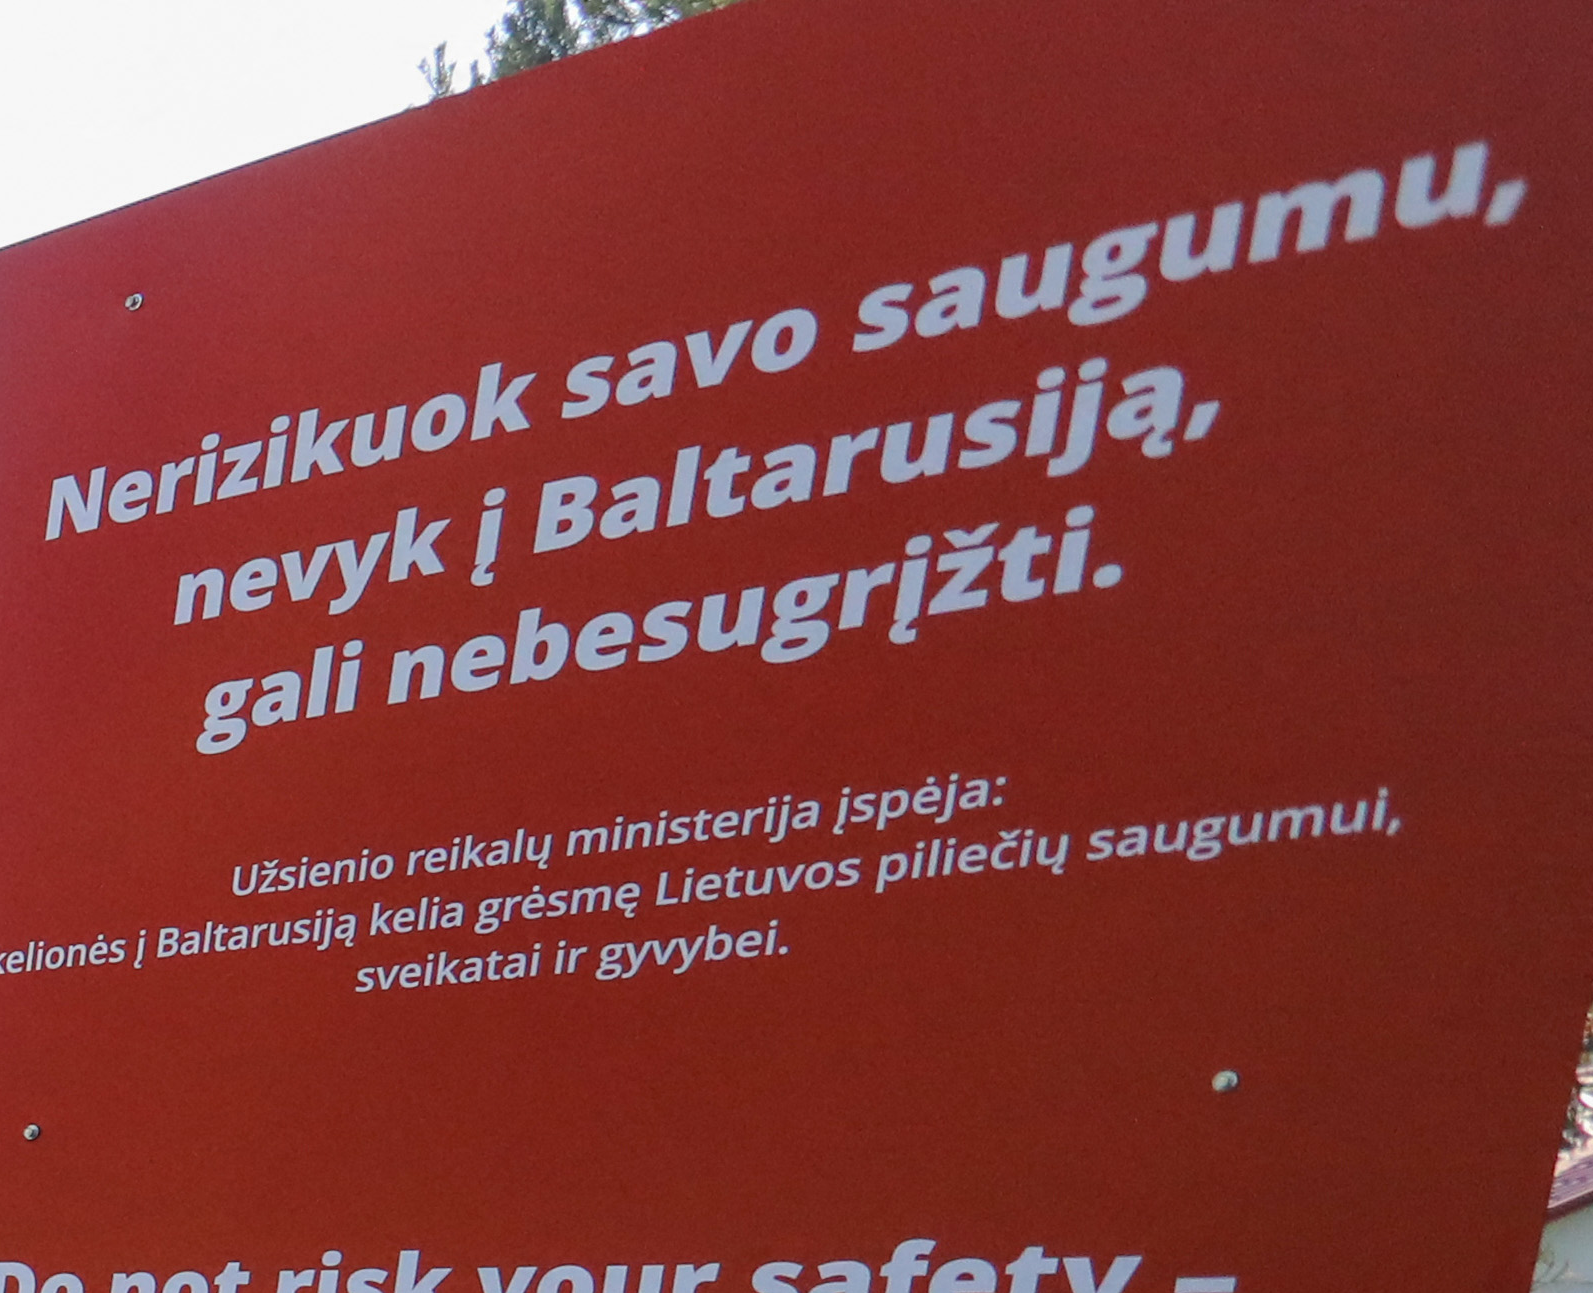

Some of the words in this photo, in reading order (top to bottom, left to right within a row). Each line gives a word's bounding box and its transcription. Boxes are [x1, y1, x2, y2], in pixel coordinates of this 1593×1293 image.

[45, 363, 536, 541] Nerizikuok
[562, 309, 817, 418] savo
[853, 143, 1525, 352] saugumu,
[174, 507, 450, 625] nevyk
[471, 488, 506, 586] į
[534, 358, 1219, 553] Baltarusiją,
[196, 640, 363, 754] gali
[388, 505, 1122, 704] nebesugrįžti.
[133, 929, 147, 969] į
[156, 908, 357, 958] Baltarusiją
[370, 896, 464, 936] kelia
[473, 882, 641, 935] grėsmę
[655, 858, 861, 906] Lietuvos
[875, 828, 1070, 894] piliečių
[1087, 787, 1401, 862] saugumui,
[231, 848, 394, 897] Užsienio
[407, 829, 552, 876] reikalų
[566, 795, 820, 857] ministerija
[833, 774, 1007, 835] įspėja:
[355, 942, 542, 993] sveikatai
[554, 940, 588, 975] ir
[595, 919, 789, 981] gyvybei.
